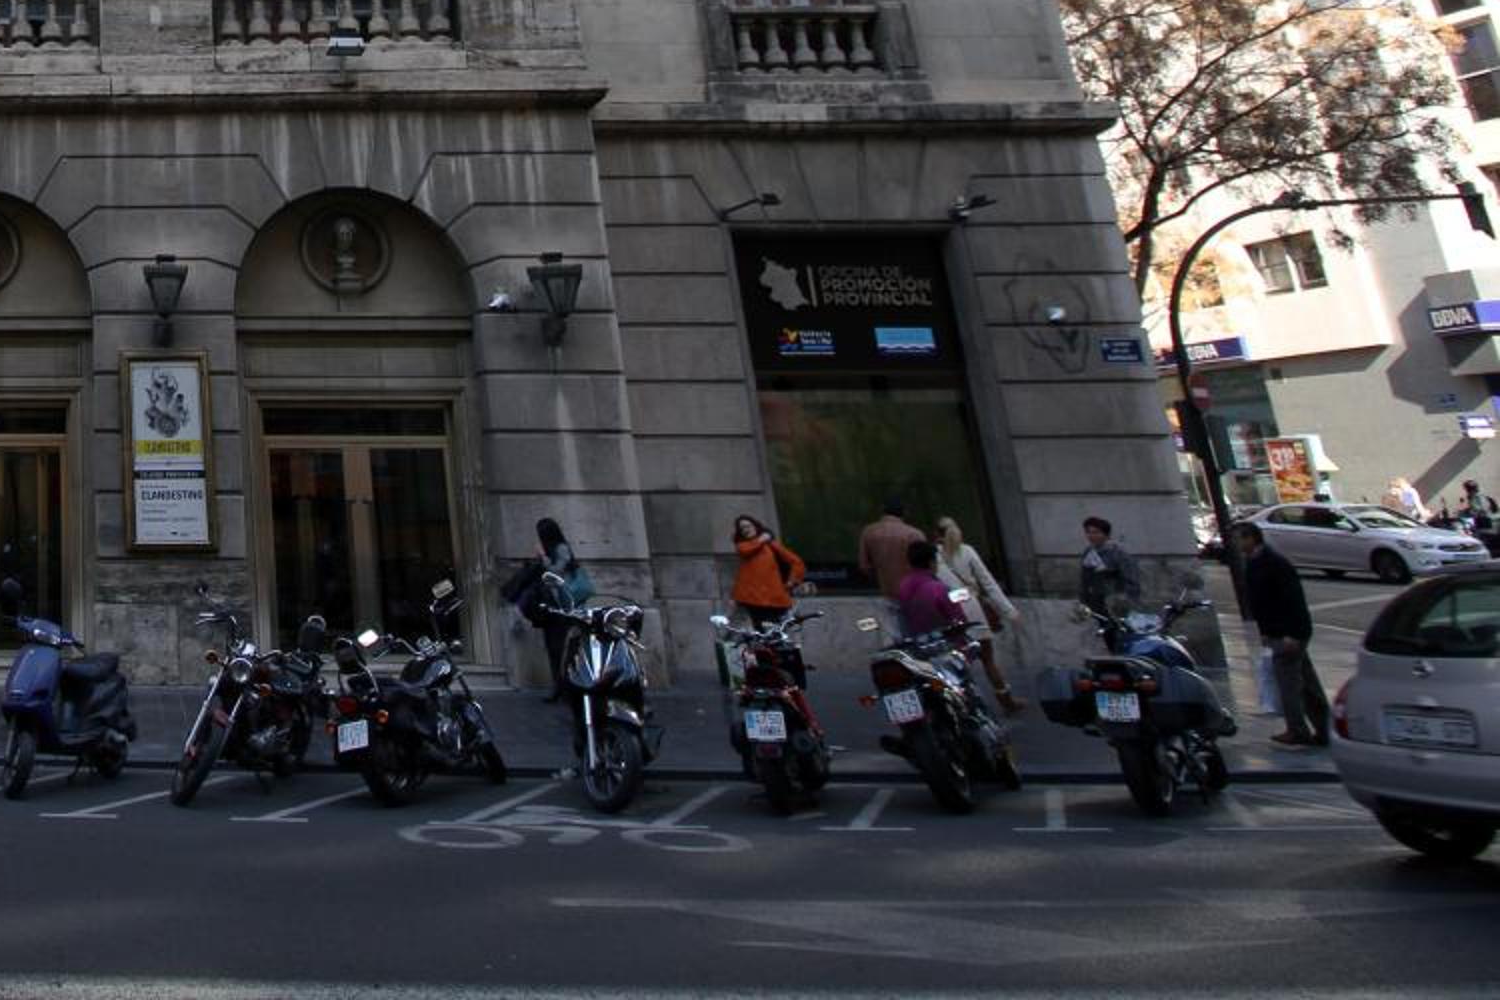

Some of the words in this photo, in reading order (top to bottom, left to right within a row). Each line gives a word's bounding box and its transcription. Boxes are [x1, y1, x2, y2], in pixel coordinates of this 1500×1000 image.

[818, 265, 880, 278] OFICINA
[883, 266, 901, 278] DE
[820, 276, 931, 292] PROMOCIÓN
[822, 291, 933, 306] PROVINCIAL
[1430, 306, 1474, 328] BBVA
[141, 489, 204, 501] CLANDESTINO
